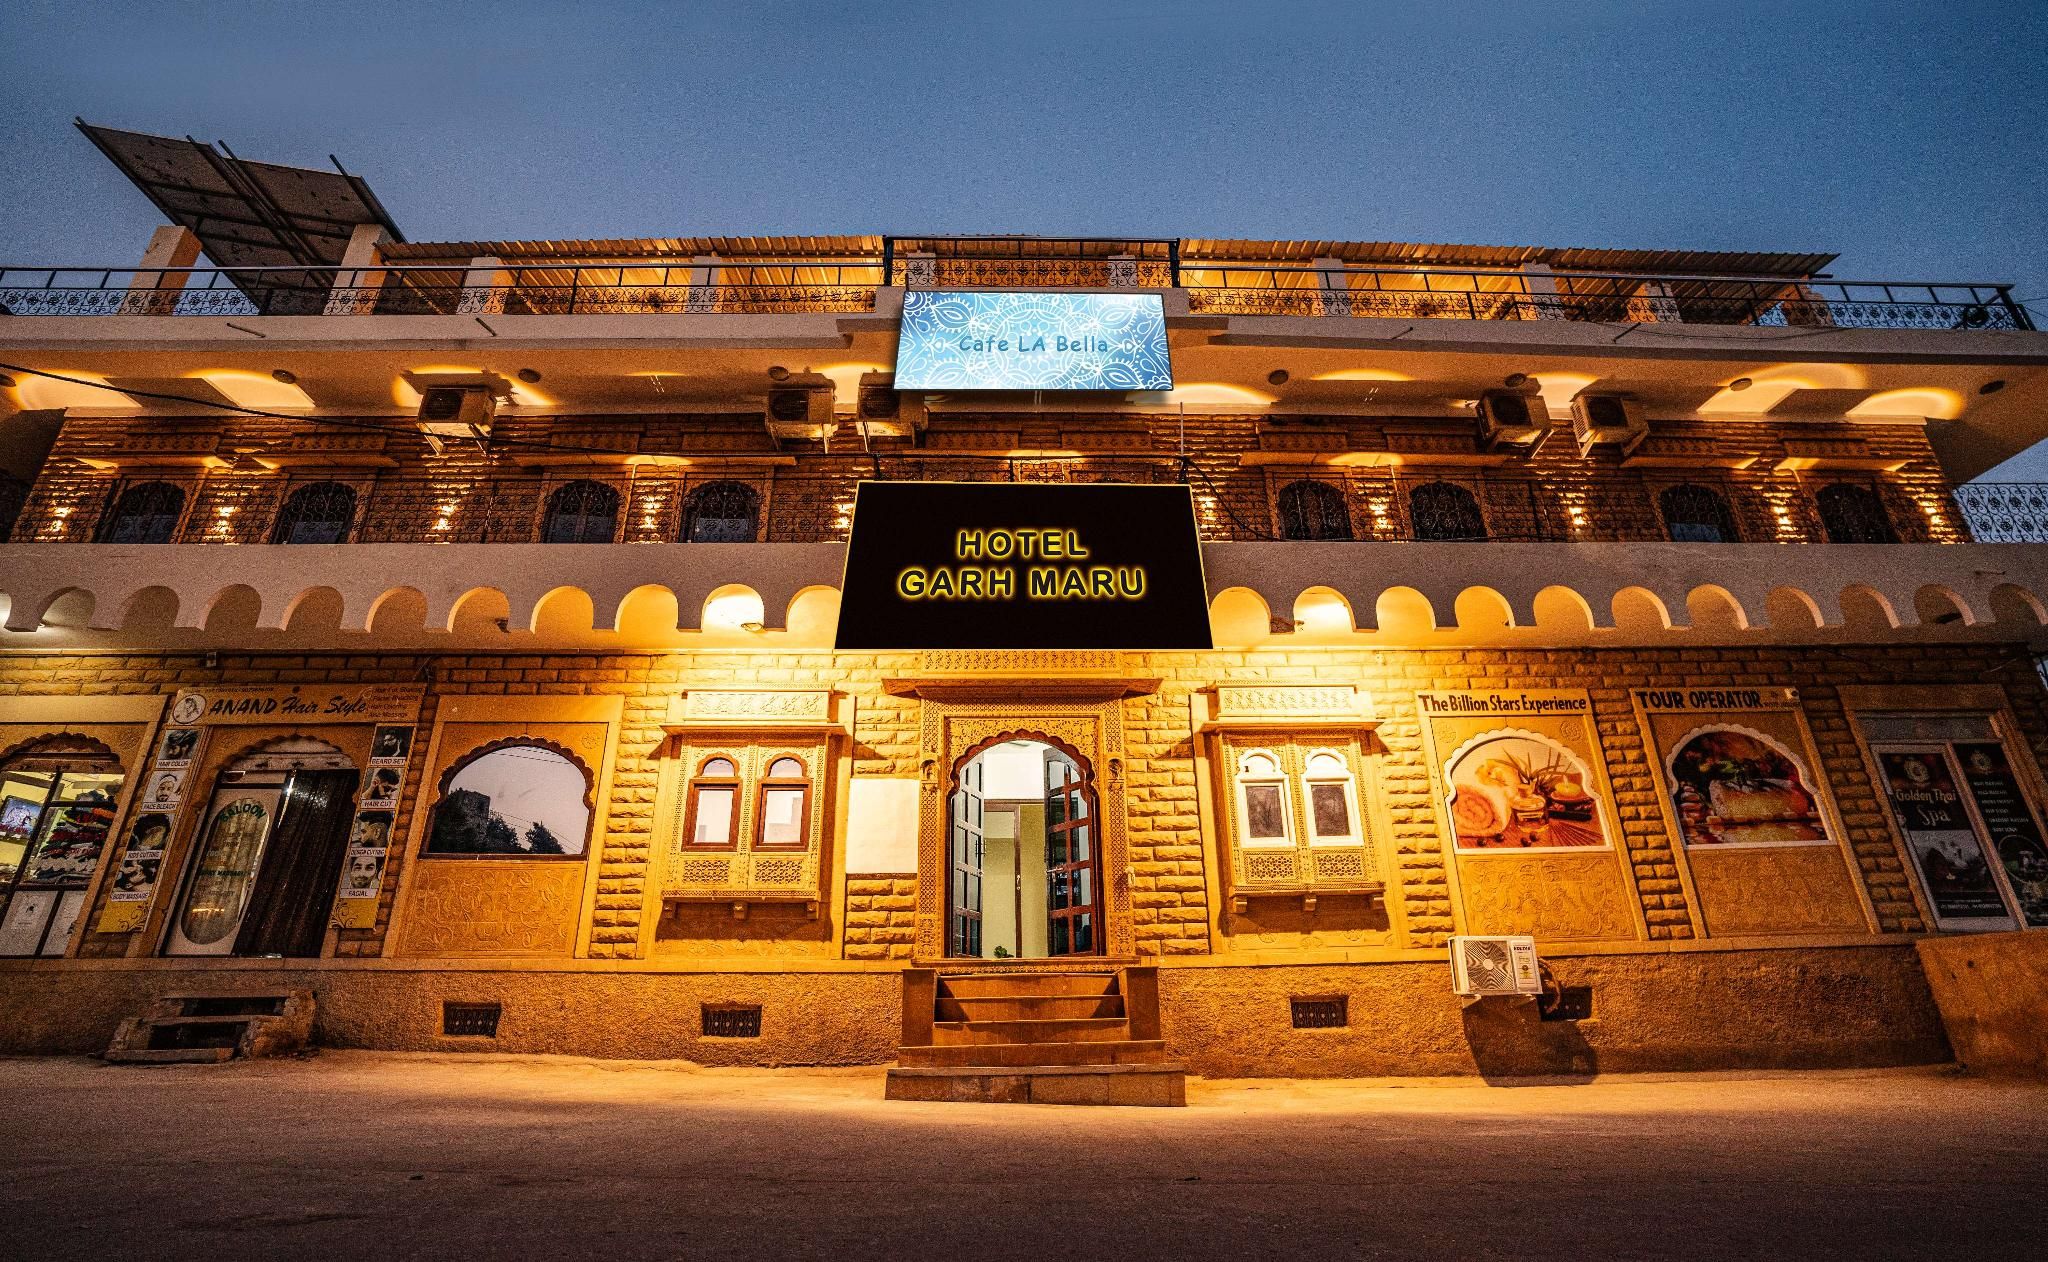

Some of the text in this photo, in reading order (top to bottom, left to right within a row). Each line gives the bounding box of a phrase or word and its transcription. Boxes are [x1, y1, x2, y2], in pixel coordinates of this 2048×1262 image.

[959, 334, 1109, 353] Cafe LA Bella
[958, 531, 1088, 557] HOTEL
[899, 569, 1146, 597] GARH MARU
[208, 696, 367, 717] ANAND Hair Style
[1419, 694, 1587, 714] The Billion Stars Experience
[1636, 691, 1684, 710] TOUR
[1689, 690, 1763, 709] OPERATOR
[1896, 788, 1957, 804] Golden Thai
[219, 803, 267, 822] SALOON
[1916, 804, 1952, 827] Spa
[140, 851, 160, 859] CUTTING
[126, 892, 150, 900] MASSAGE
